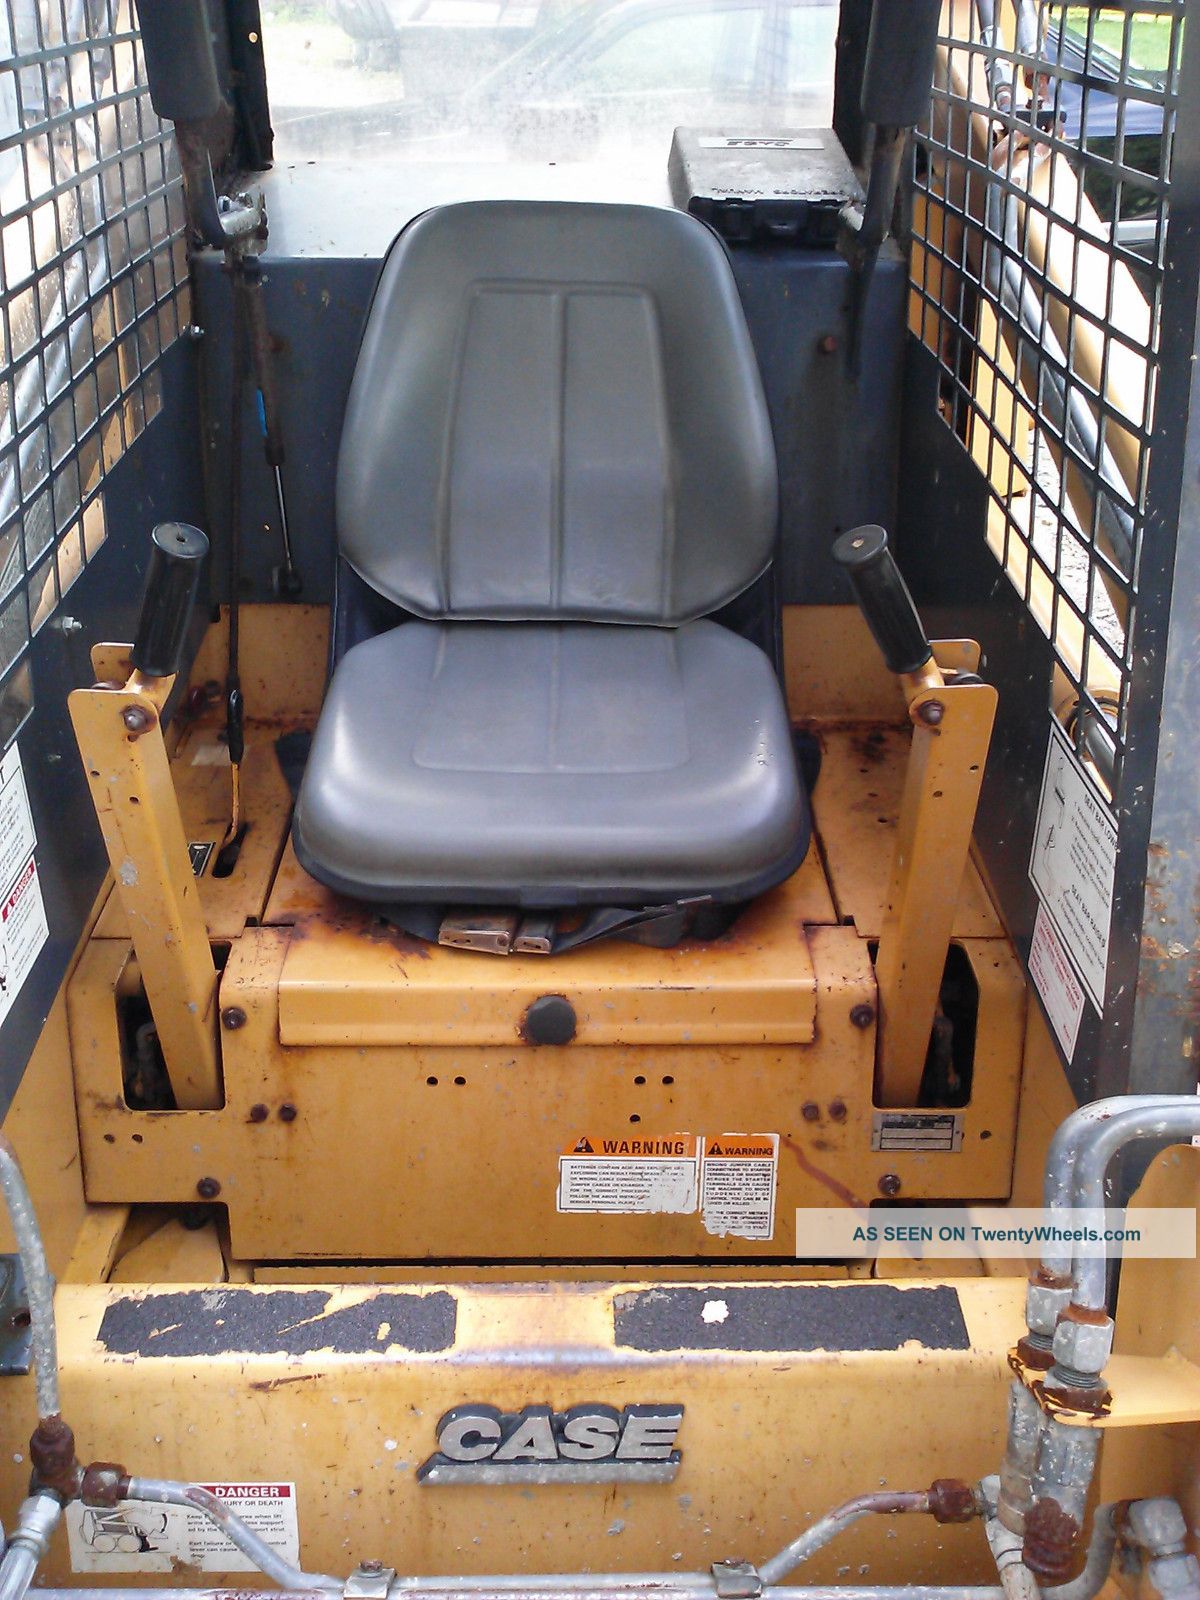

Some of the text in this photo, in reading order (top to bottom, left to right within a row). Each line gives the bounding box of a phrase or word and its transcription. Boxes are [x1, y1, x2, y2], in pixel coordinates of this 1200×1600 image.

[603, 1140, 685, 1155] WARNING
[725, 1146, 773, 1156] WARNING
[436, 1403, 684, 1462] CASE
[215, 1487, 279, 1497] DANGER
